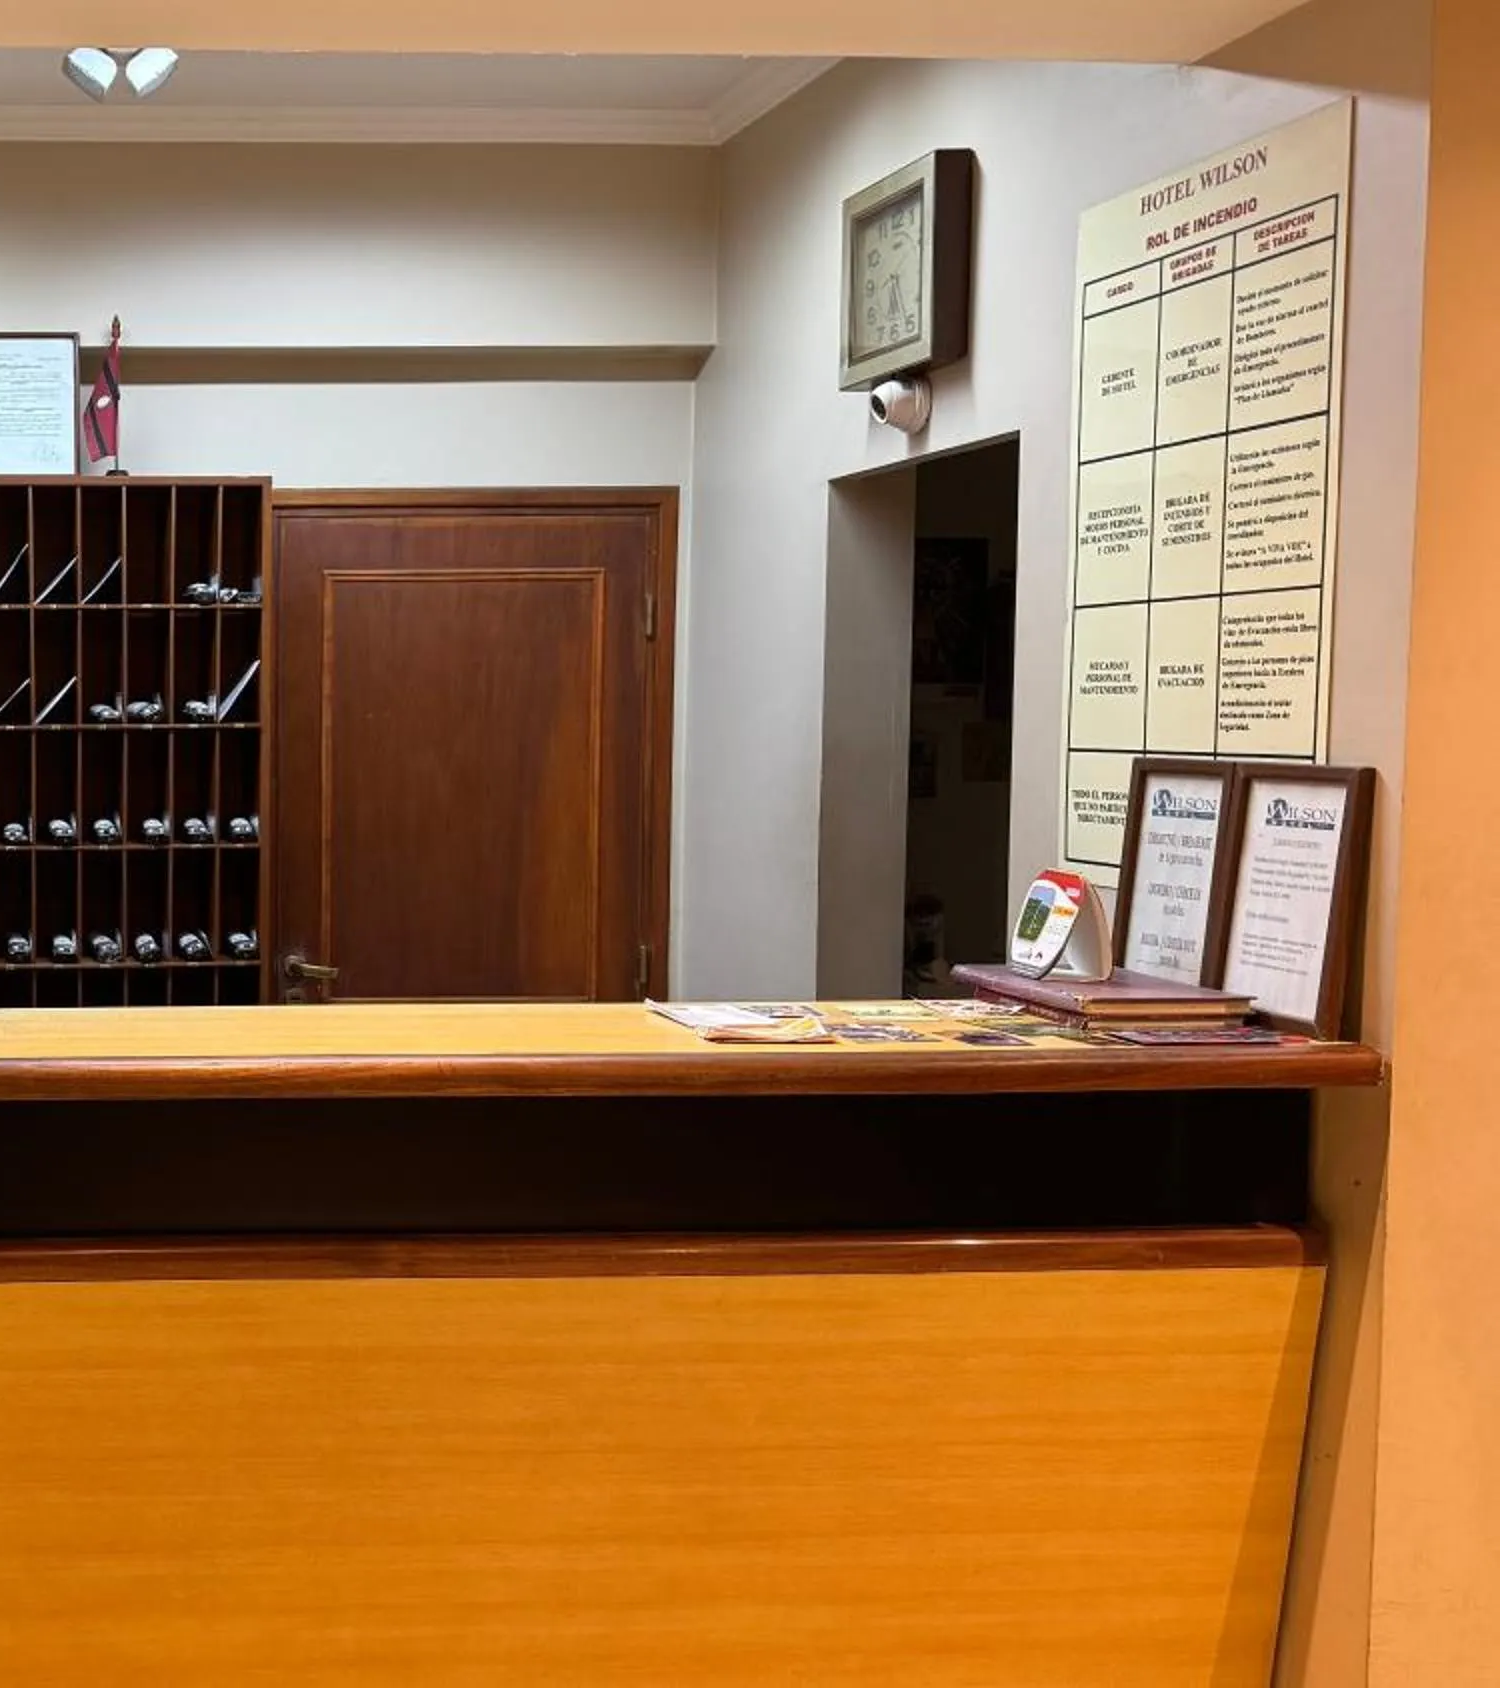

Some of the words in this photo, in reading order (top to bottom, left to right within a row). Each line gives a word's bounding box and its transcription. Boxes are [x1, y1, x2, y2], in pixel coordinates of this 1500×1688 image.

[1140, 178, 1196, 216] HOTEL
[1199, 147, 1268, 190] WILSON
[1146, 235, 1170, 251] ROL
[1173, 221, 1190, 241] DE
[1193, 197, 1258, 233] INCENDIO
[1257, 241, 1271, 253] DE
[1272, 228, 1308, 247] TAREAS
[1169, 250, 1203, 271] GRUPOS
[1205, 246, 1217, 258] DE
[1171, 260, 1215, 282] BRIGADAS
[1106, 281, 1135, 298] CARGO
[1165, 364, 1221, 386] EMERGENCIAS
[1112, 380, 1136, 394] HOTEL
[1165, 495, 1199, 509] BRIGADA
[1086, 673, 1121, 683] PERSONAL
[1159, 664, 1192, 675] BRIGADA
[1102, 791, 1128, 801] PERSON
[1077, 813, 1125, 826] DIRECTAMENT
